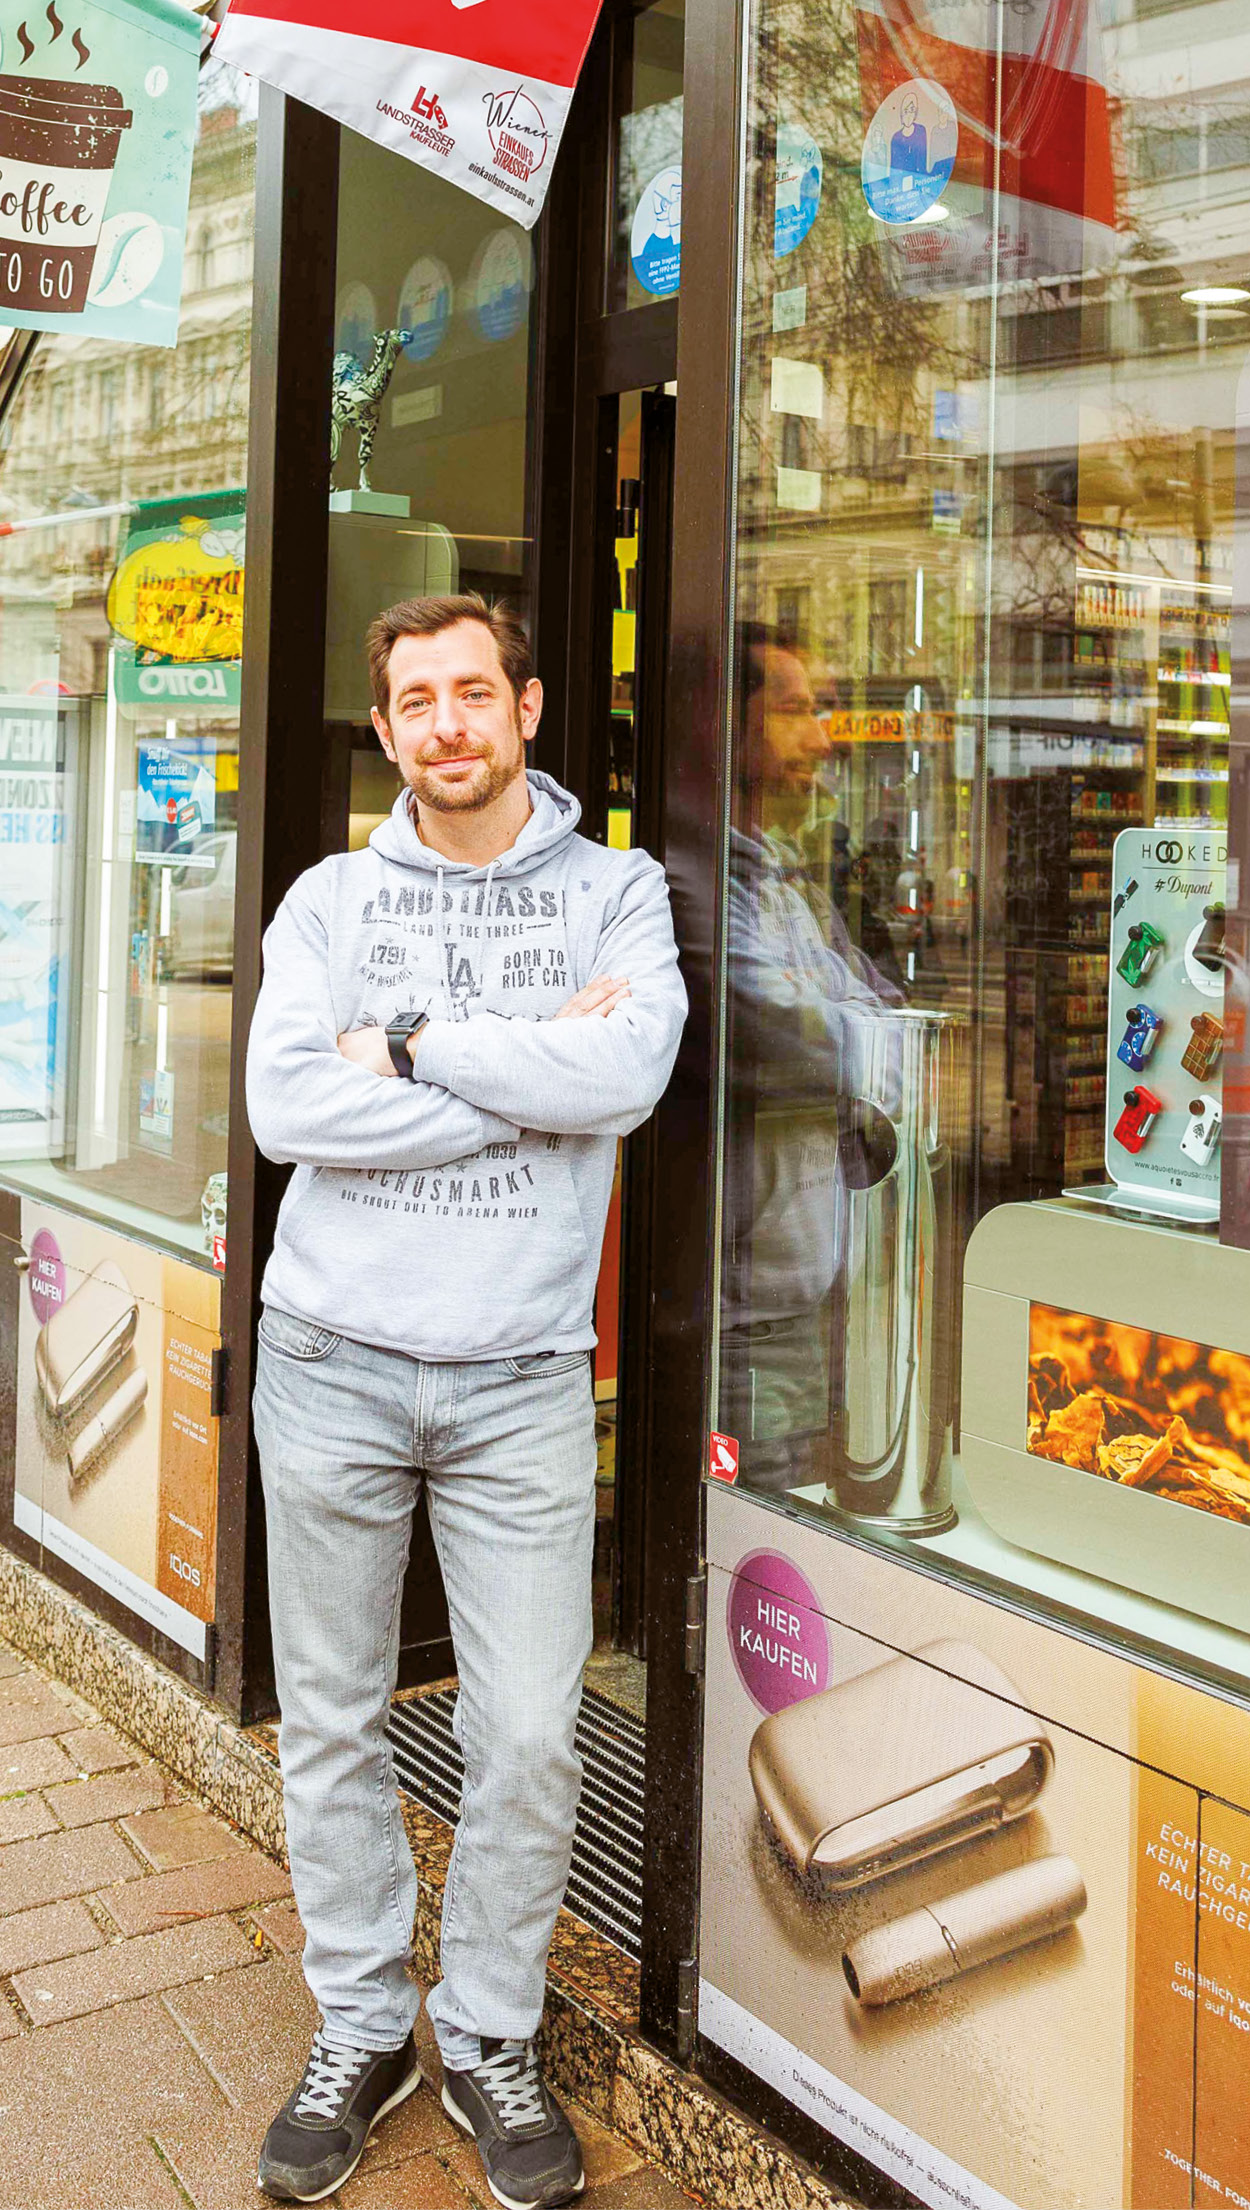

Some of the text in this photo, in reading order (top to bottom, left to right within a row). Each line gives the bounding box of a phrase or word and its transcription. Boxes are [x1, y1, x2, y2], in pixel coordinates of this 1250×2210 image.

[376, 99, 456, 149] LANDSTRASSER
[482, 84, 553, 140] Wiener
[409, 130, 451, 158] KAUFLEUTE
[498, 131, 534, 167] EINKAUFS
[493, 149, 530, 183] STRASSEN
[468, 162, 535, 208] einkaufsstrassen.at
[0, 178, 93, 236] offee
[40, 258, 73, 299] GO
[147, 764, 157, 776] den
[1142, 841, 1228, 864] HOOKED
[1155, 876, 1213, 899] #Dupont
[403, 926, 434, 937] LAND
[460, 924, 481, 939] THE
[486, 922, 525, 939] THREE
[369, 943, 407, 966] 1791
[503, 949, 565, 970] BORN TO
[502, 968, 567, 989] RIDE CAT
[341, 1188, 539, 1219] BIG SHOUT OUT TO ARENA WIEN
[39, 1258, 57, 1279] HIER
[32, 1275, 63, 1304] KAUFEN
[166, 1350, 180, 1364] KEIN
[170, 1337, 193, 1357] ECHTER
[713, 1434, 728, 1447] VIDEO
[169, 1552, 201, 1588] IQOS
[757, 1598, 801, 1641] HIER
[740, 1624, 818, 1686] KAUFEN
[1146, 1842, 1189, 1875] KEIN
[1160, 1824, 1232, 1872] ECHTER
[1205, 1999, 1225, 2017] auf
